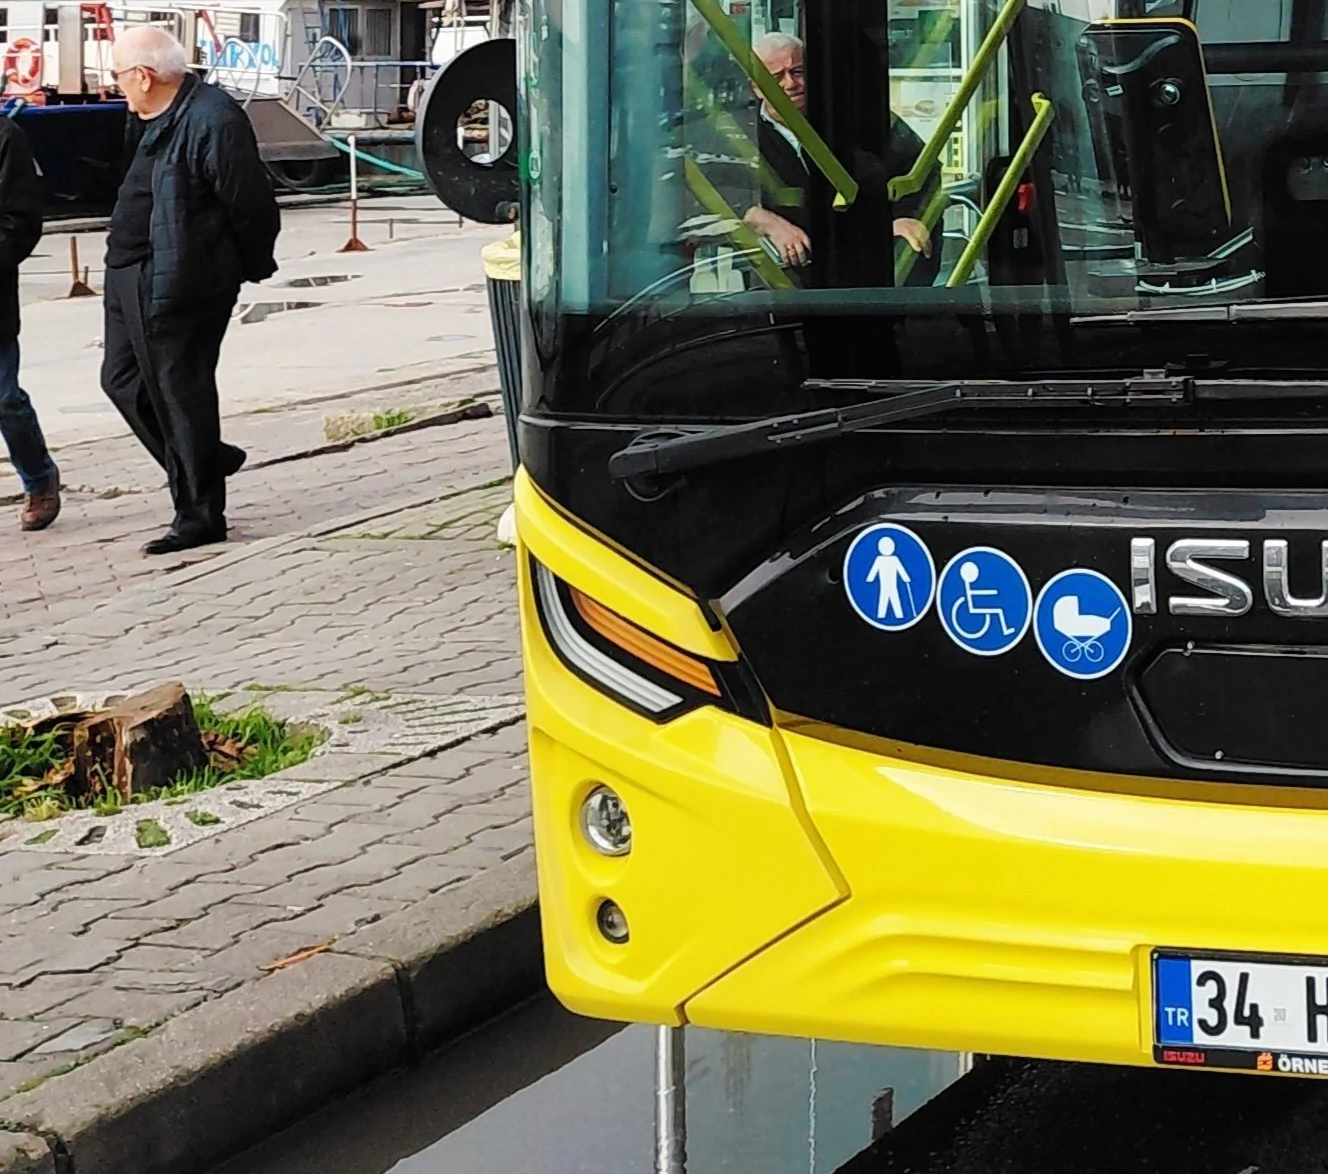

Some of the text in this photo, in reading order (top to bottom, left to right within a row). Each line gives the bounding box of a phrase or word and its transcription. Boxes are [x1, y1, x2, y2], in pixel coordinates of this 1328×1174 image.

[1197, 970, 1264, 1039] 34
[1165, 1007, 1189, 1026] TR
[1163, 1050, 1205, 1064] ISUZU
